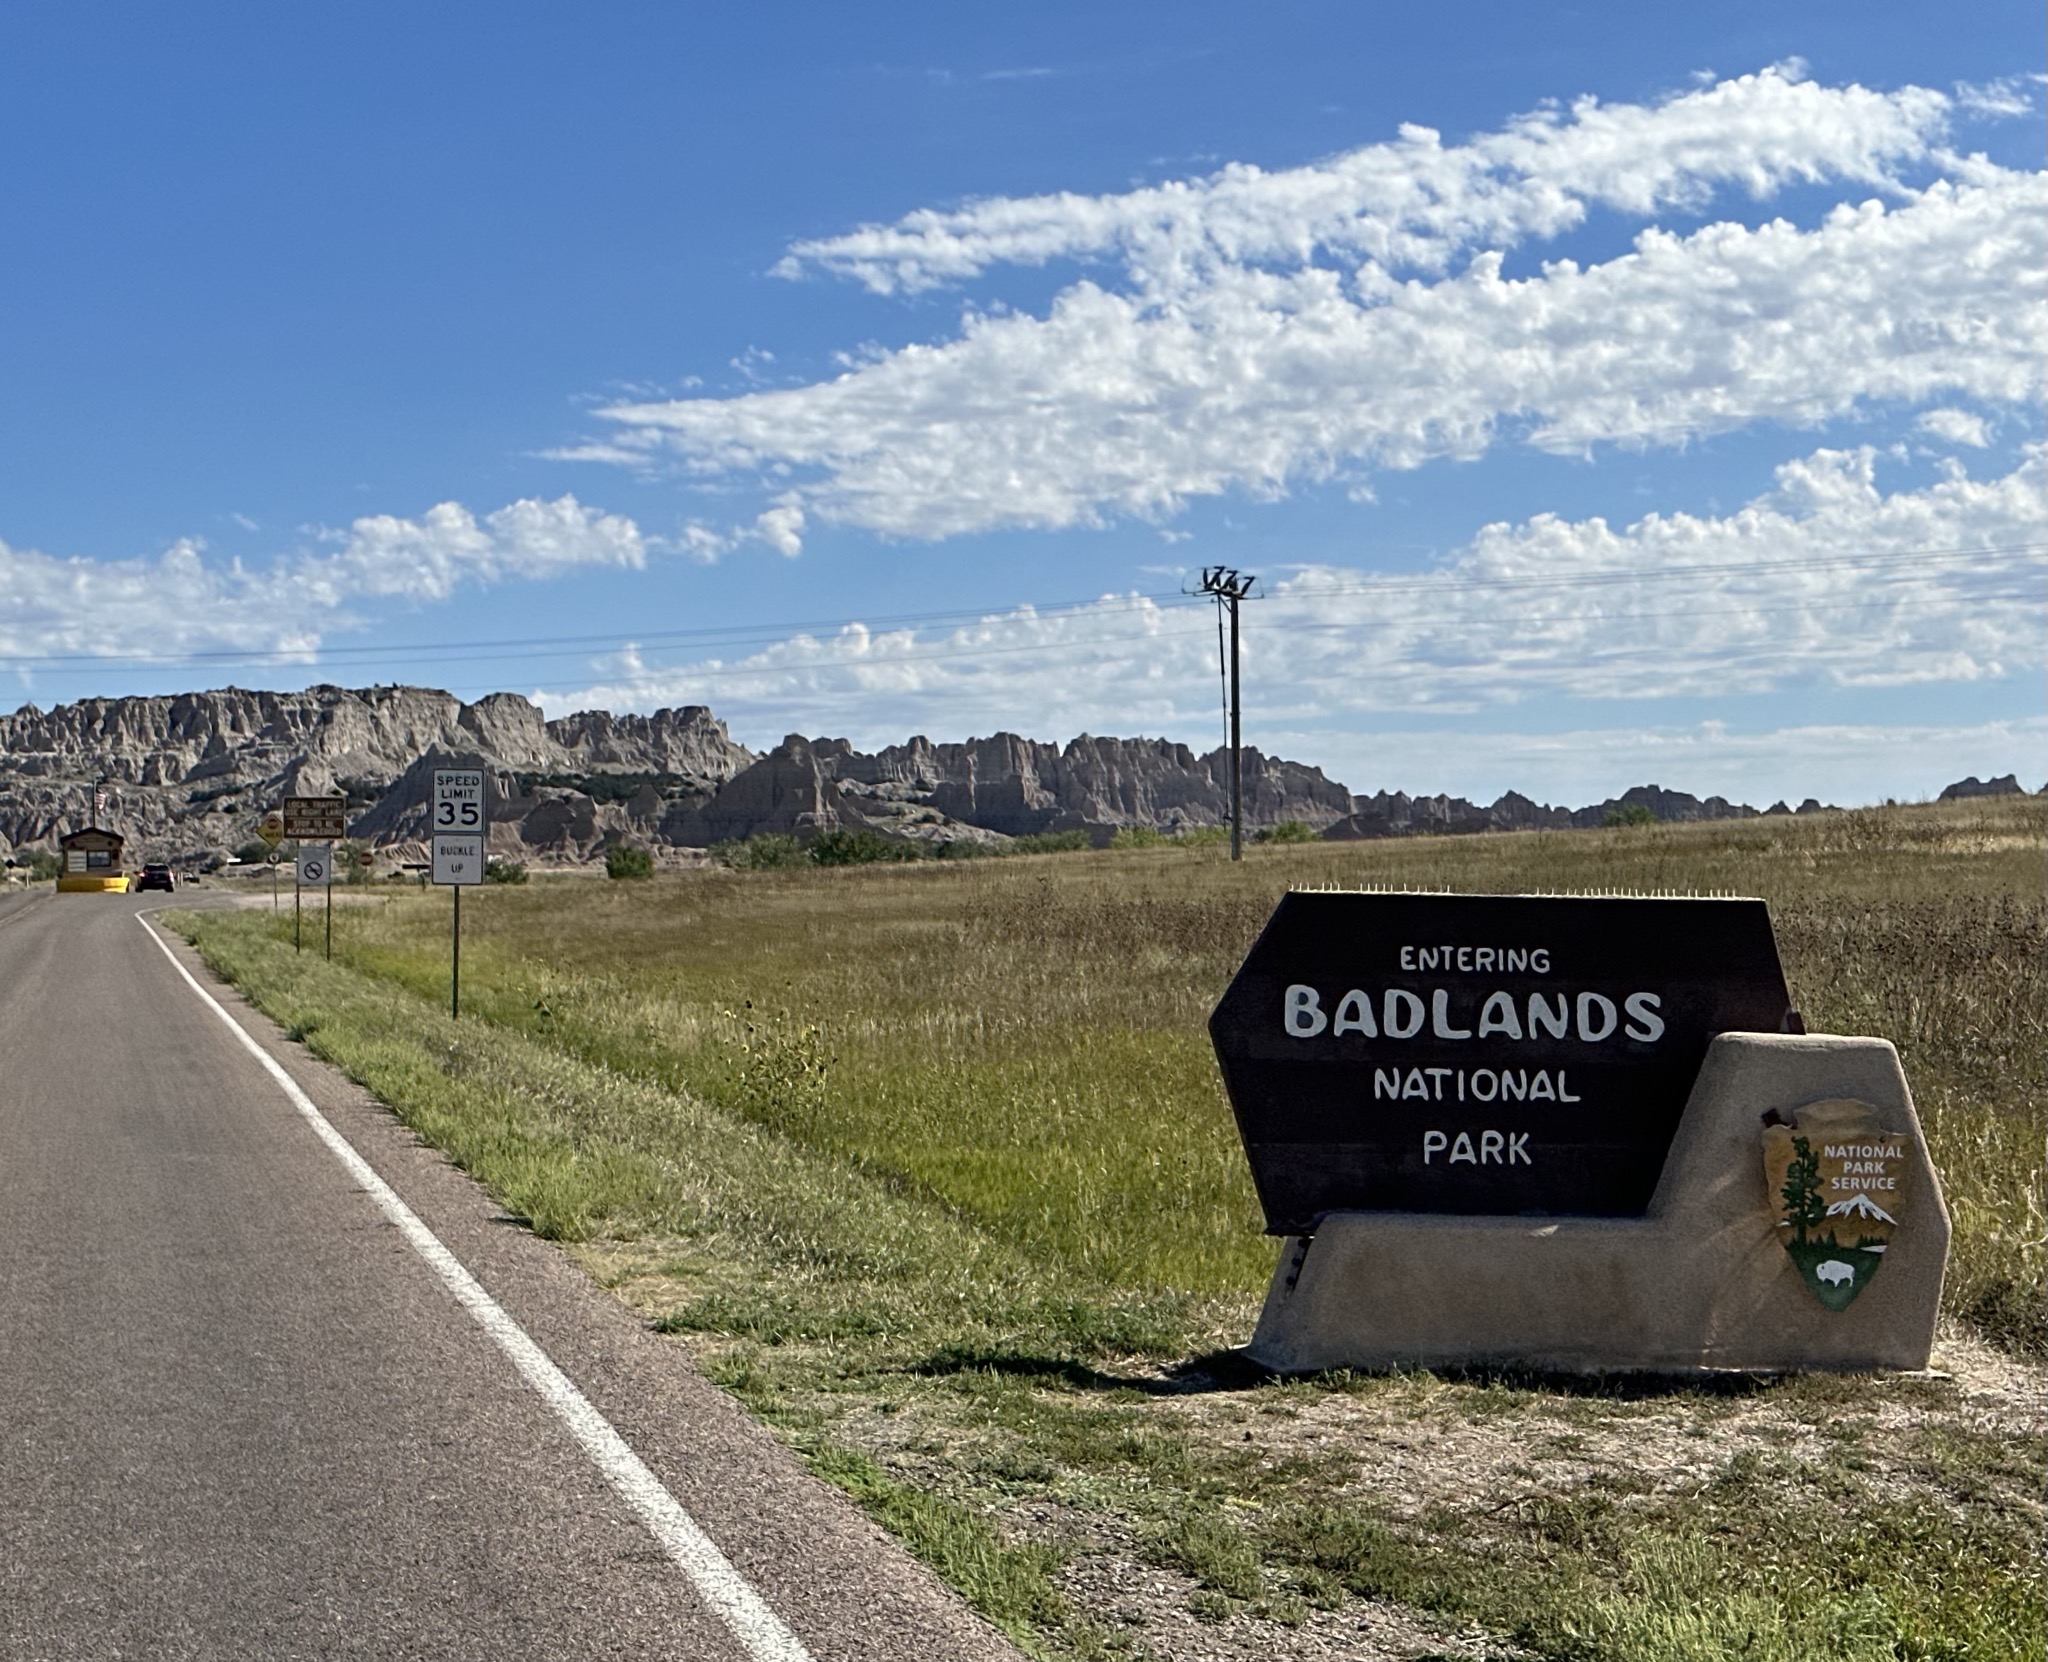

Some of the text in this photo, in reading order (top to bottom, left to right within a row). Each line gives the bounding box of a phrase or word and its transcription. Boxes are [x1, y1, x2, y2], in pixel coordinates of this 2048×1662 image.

[437, 775, 480, 787] SPEED
[441, 788, 475, 799] LIMIT
[437, 802, 479, 826] 35
[440, 845, 475, 856] BUCKLE
[451, 863, 464, 874] UP
[1400, 945, 1551, 974] ENTERING
[1284, 984, 1665, 1043] BADLANDS
[1374, 1067, 1581, 1103] NATIONAL
[1423, 1129, 1532, 1166] PARK
[1824, 1145, 1904, 1159] NATIONAL
[1843, 1161, 1885, 1174] PARK
[1831, 1177, 1896, 1190] SERVICE
